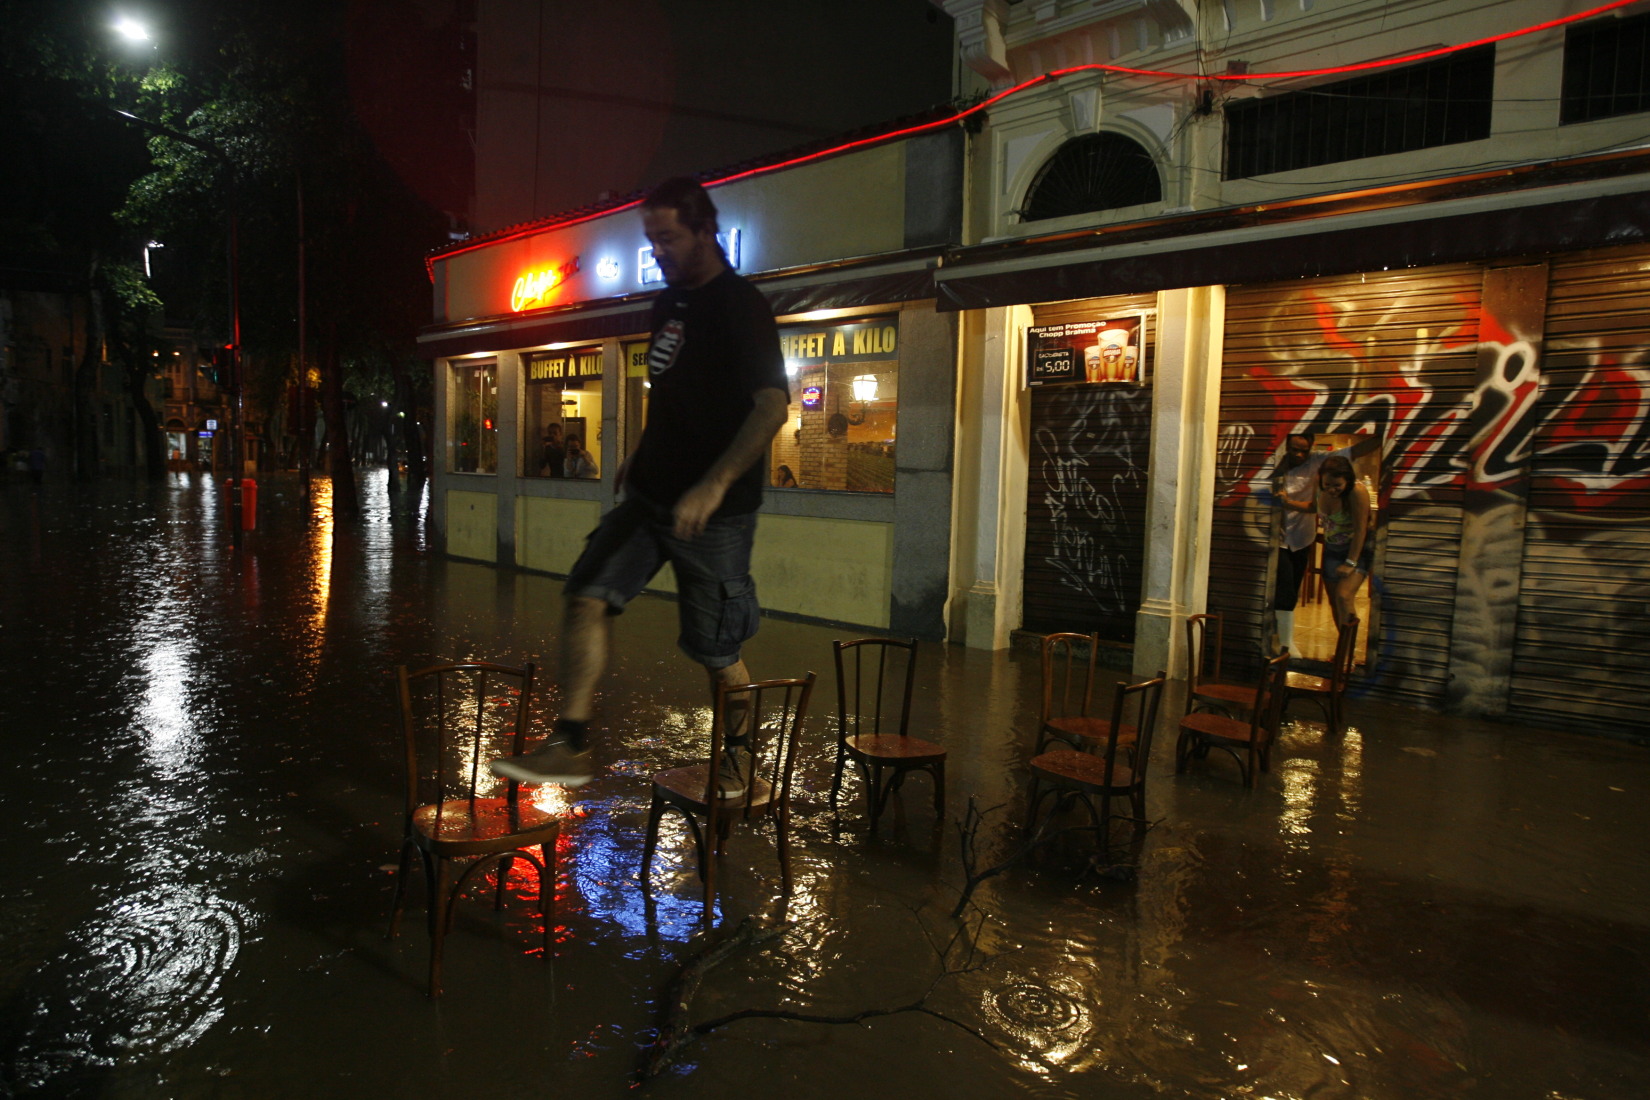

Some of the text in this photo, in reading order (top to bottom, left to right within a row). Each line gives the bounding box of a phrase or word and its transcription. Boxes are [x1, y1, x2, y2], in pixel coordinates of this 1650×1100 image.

[779, 332, 827, 359] UFFET
[853, 326, 896, 354] KILO
[530, 358, 566, 380] BUFFET
[580, 355, 603, 376] KILO
[1046, 360, 1070, 373] 5,00
